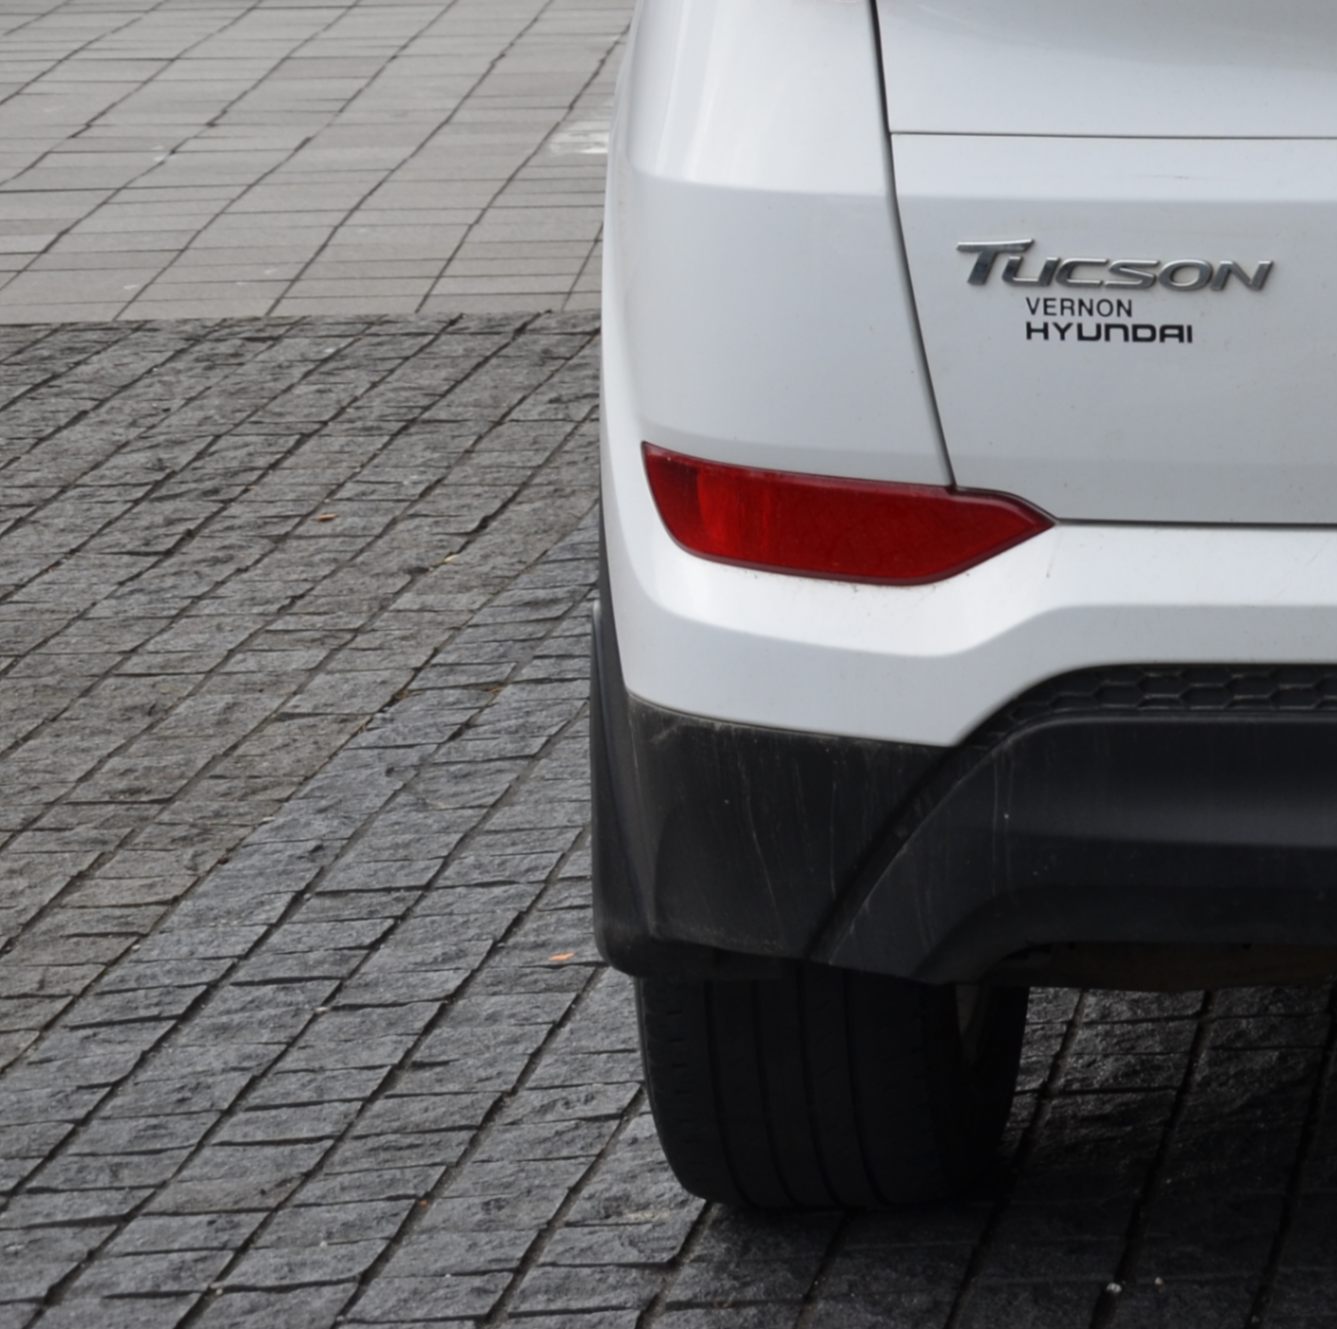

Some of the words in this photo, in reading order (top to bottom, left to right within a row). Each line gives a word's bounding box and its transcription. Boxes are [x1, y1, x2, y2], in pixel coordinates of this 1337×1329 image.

[956, 237, 1274, 292] TUCSON
[1025, 296, 1133, 319] VERNON
[1025, 321, 1194, 344] HYUNDAI
